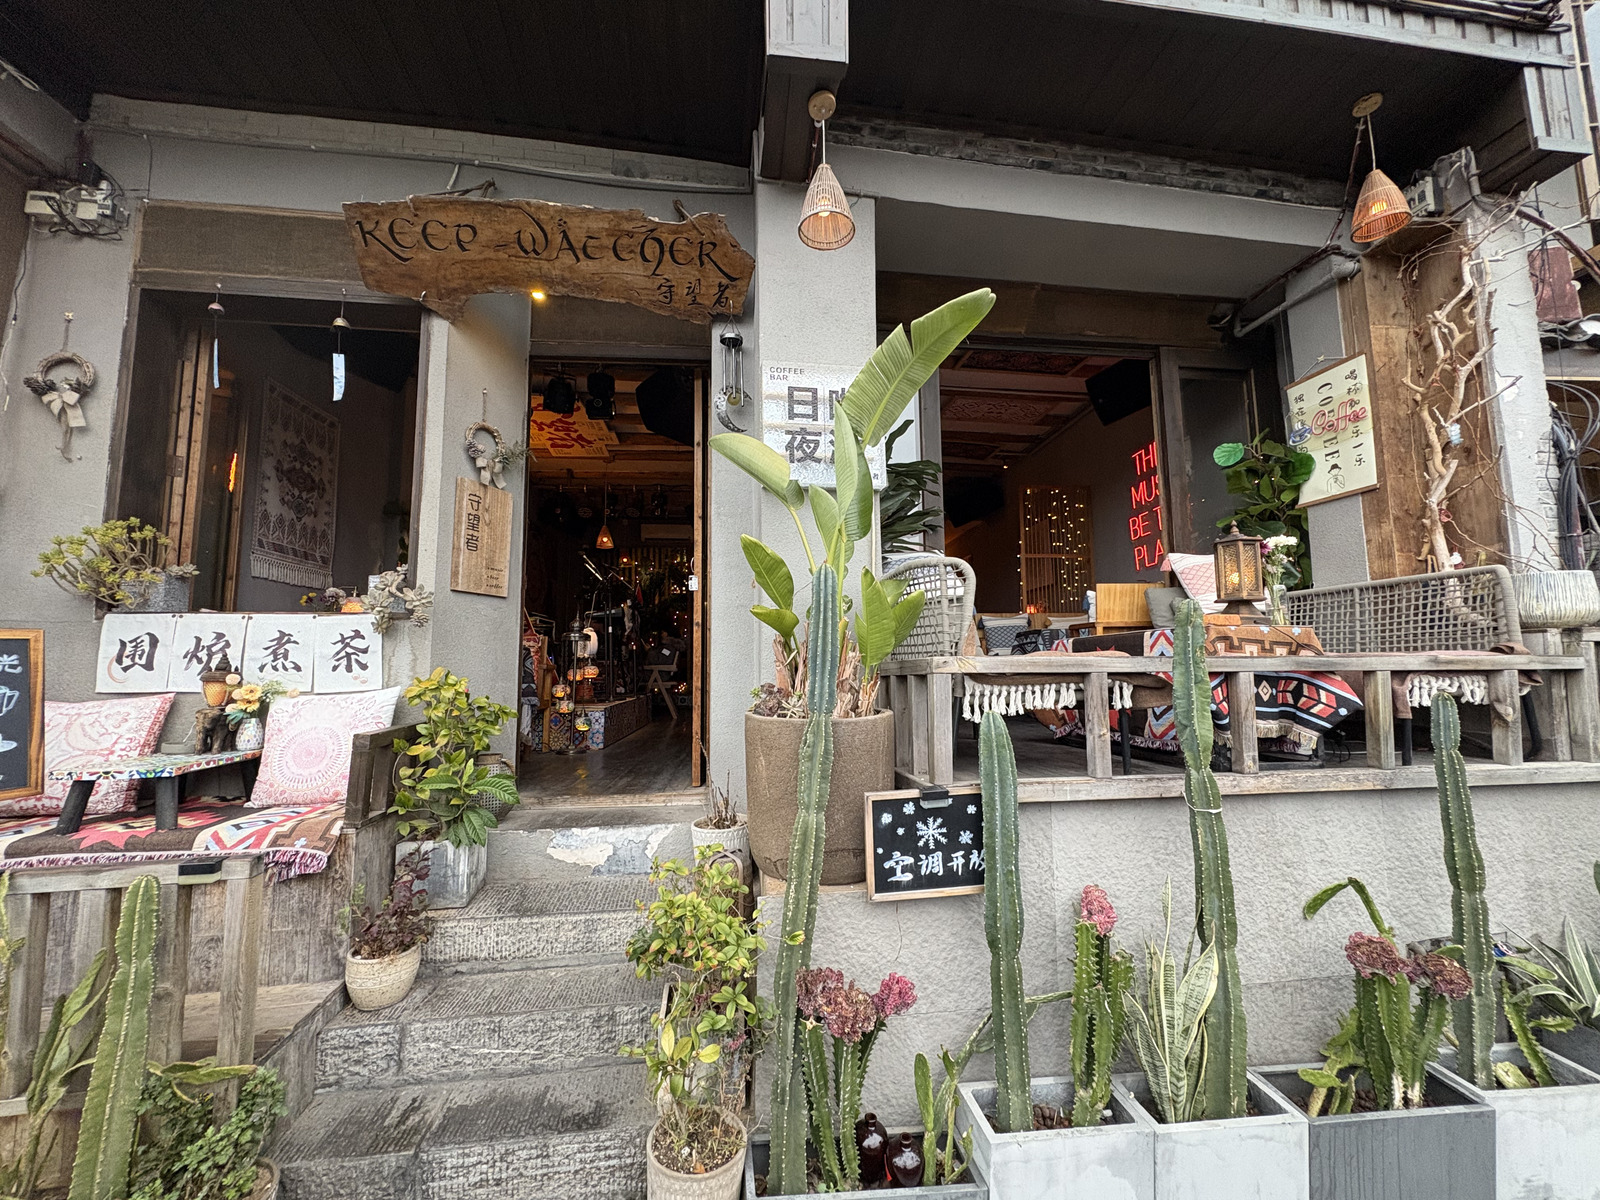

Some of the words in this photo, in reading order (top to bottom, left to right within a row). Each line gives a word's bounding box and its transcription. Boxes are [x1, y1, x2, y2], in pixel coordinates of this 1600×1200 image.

[355, 217, 478, 264] KEEP
[656, 277, 730, 308] 守望者
[769, 366, 805, 375] COFFEE
[769, 373, 789, 381] BAR
[787, 385, 846, 421] 日
[1311, 397, 1369, 436] Coffee
[785, 427, 836, 465] 夜
[466, 492, 482, 552] 守望者
[1129, 511, 1151, 541] BE
[1134, 538, 1165, 571] PLA
[114, 629, 371, 676] 围炉煮茶
[882, 849, 986, 882] 空调开放
